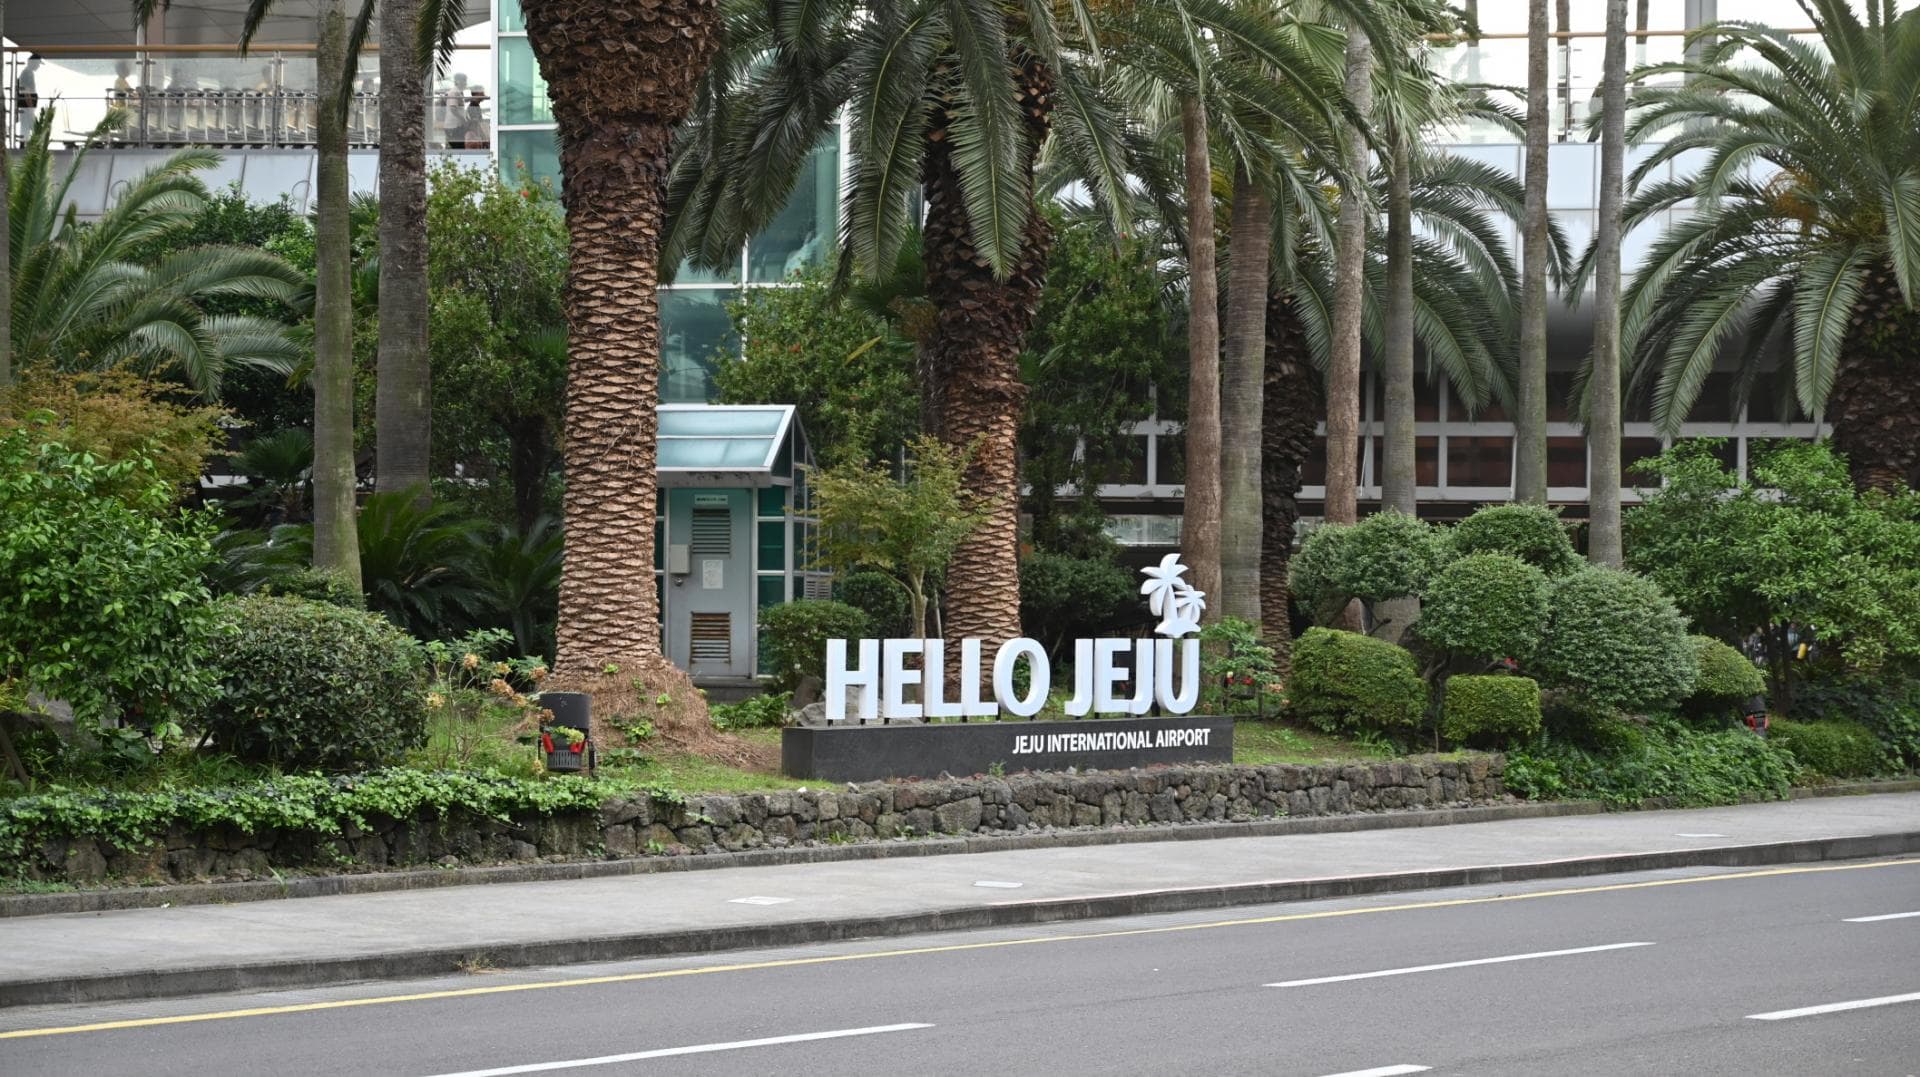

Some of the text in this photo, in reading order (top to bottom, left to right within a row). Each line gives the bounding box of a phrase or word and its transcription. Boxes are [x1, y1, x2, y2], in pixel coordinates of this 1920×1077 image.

[826, 638, 1200, 720] HELLO JEJU
[1012, 728, 1211, 754] JEJU INTERNATIONAL AIRPORT
